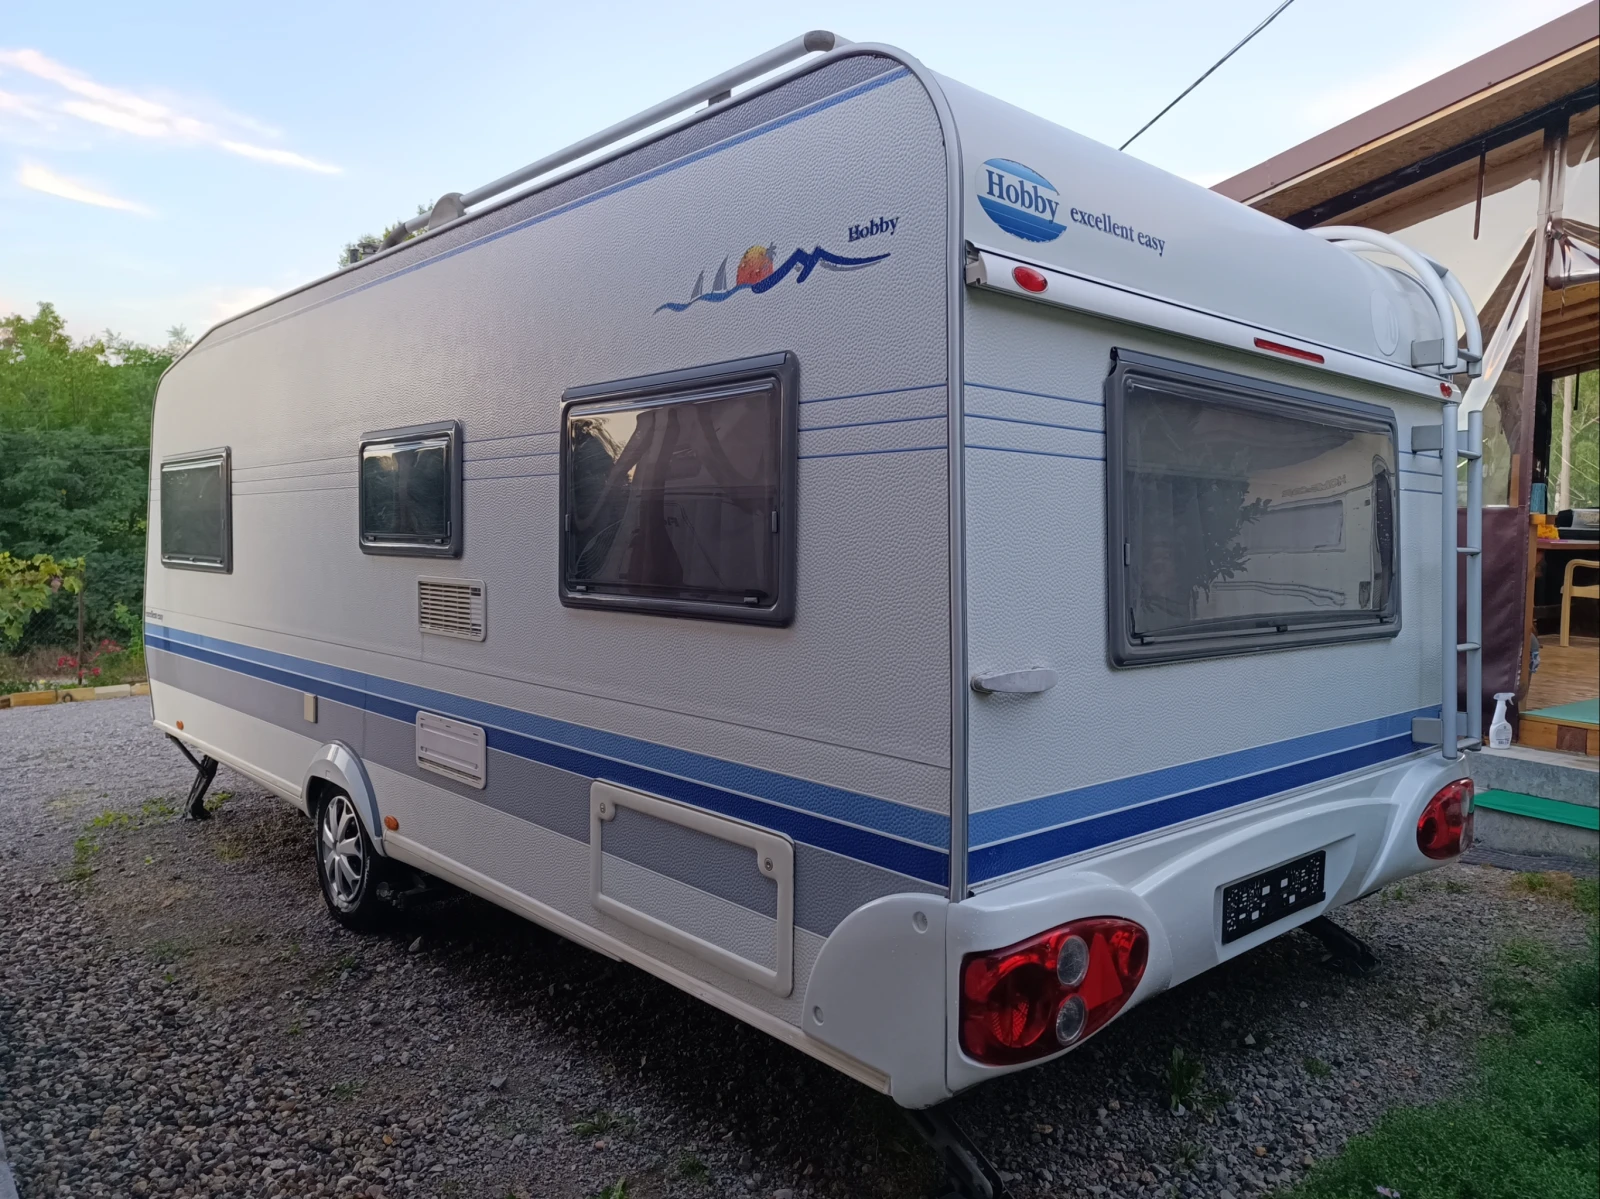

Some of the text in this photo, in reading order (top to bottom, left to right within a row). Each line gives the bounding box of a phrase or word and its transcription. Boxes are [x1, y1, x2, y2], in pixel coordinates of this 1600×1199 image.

[985, 168, 1060, 224] Hobby
[847, 216, 900, 242] Hobby
[1069, 206, 1166, 257] excellent easy
